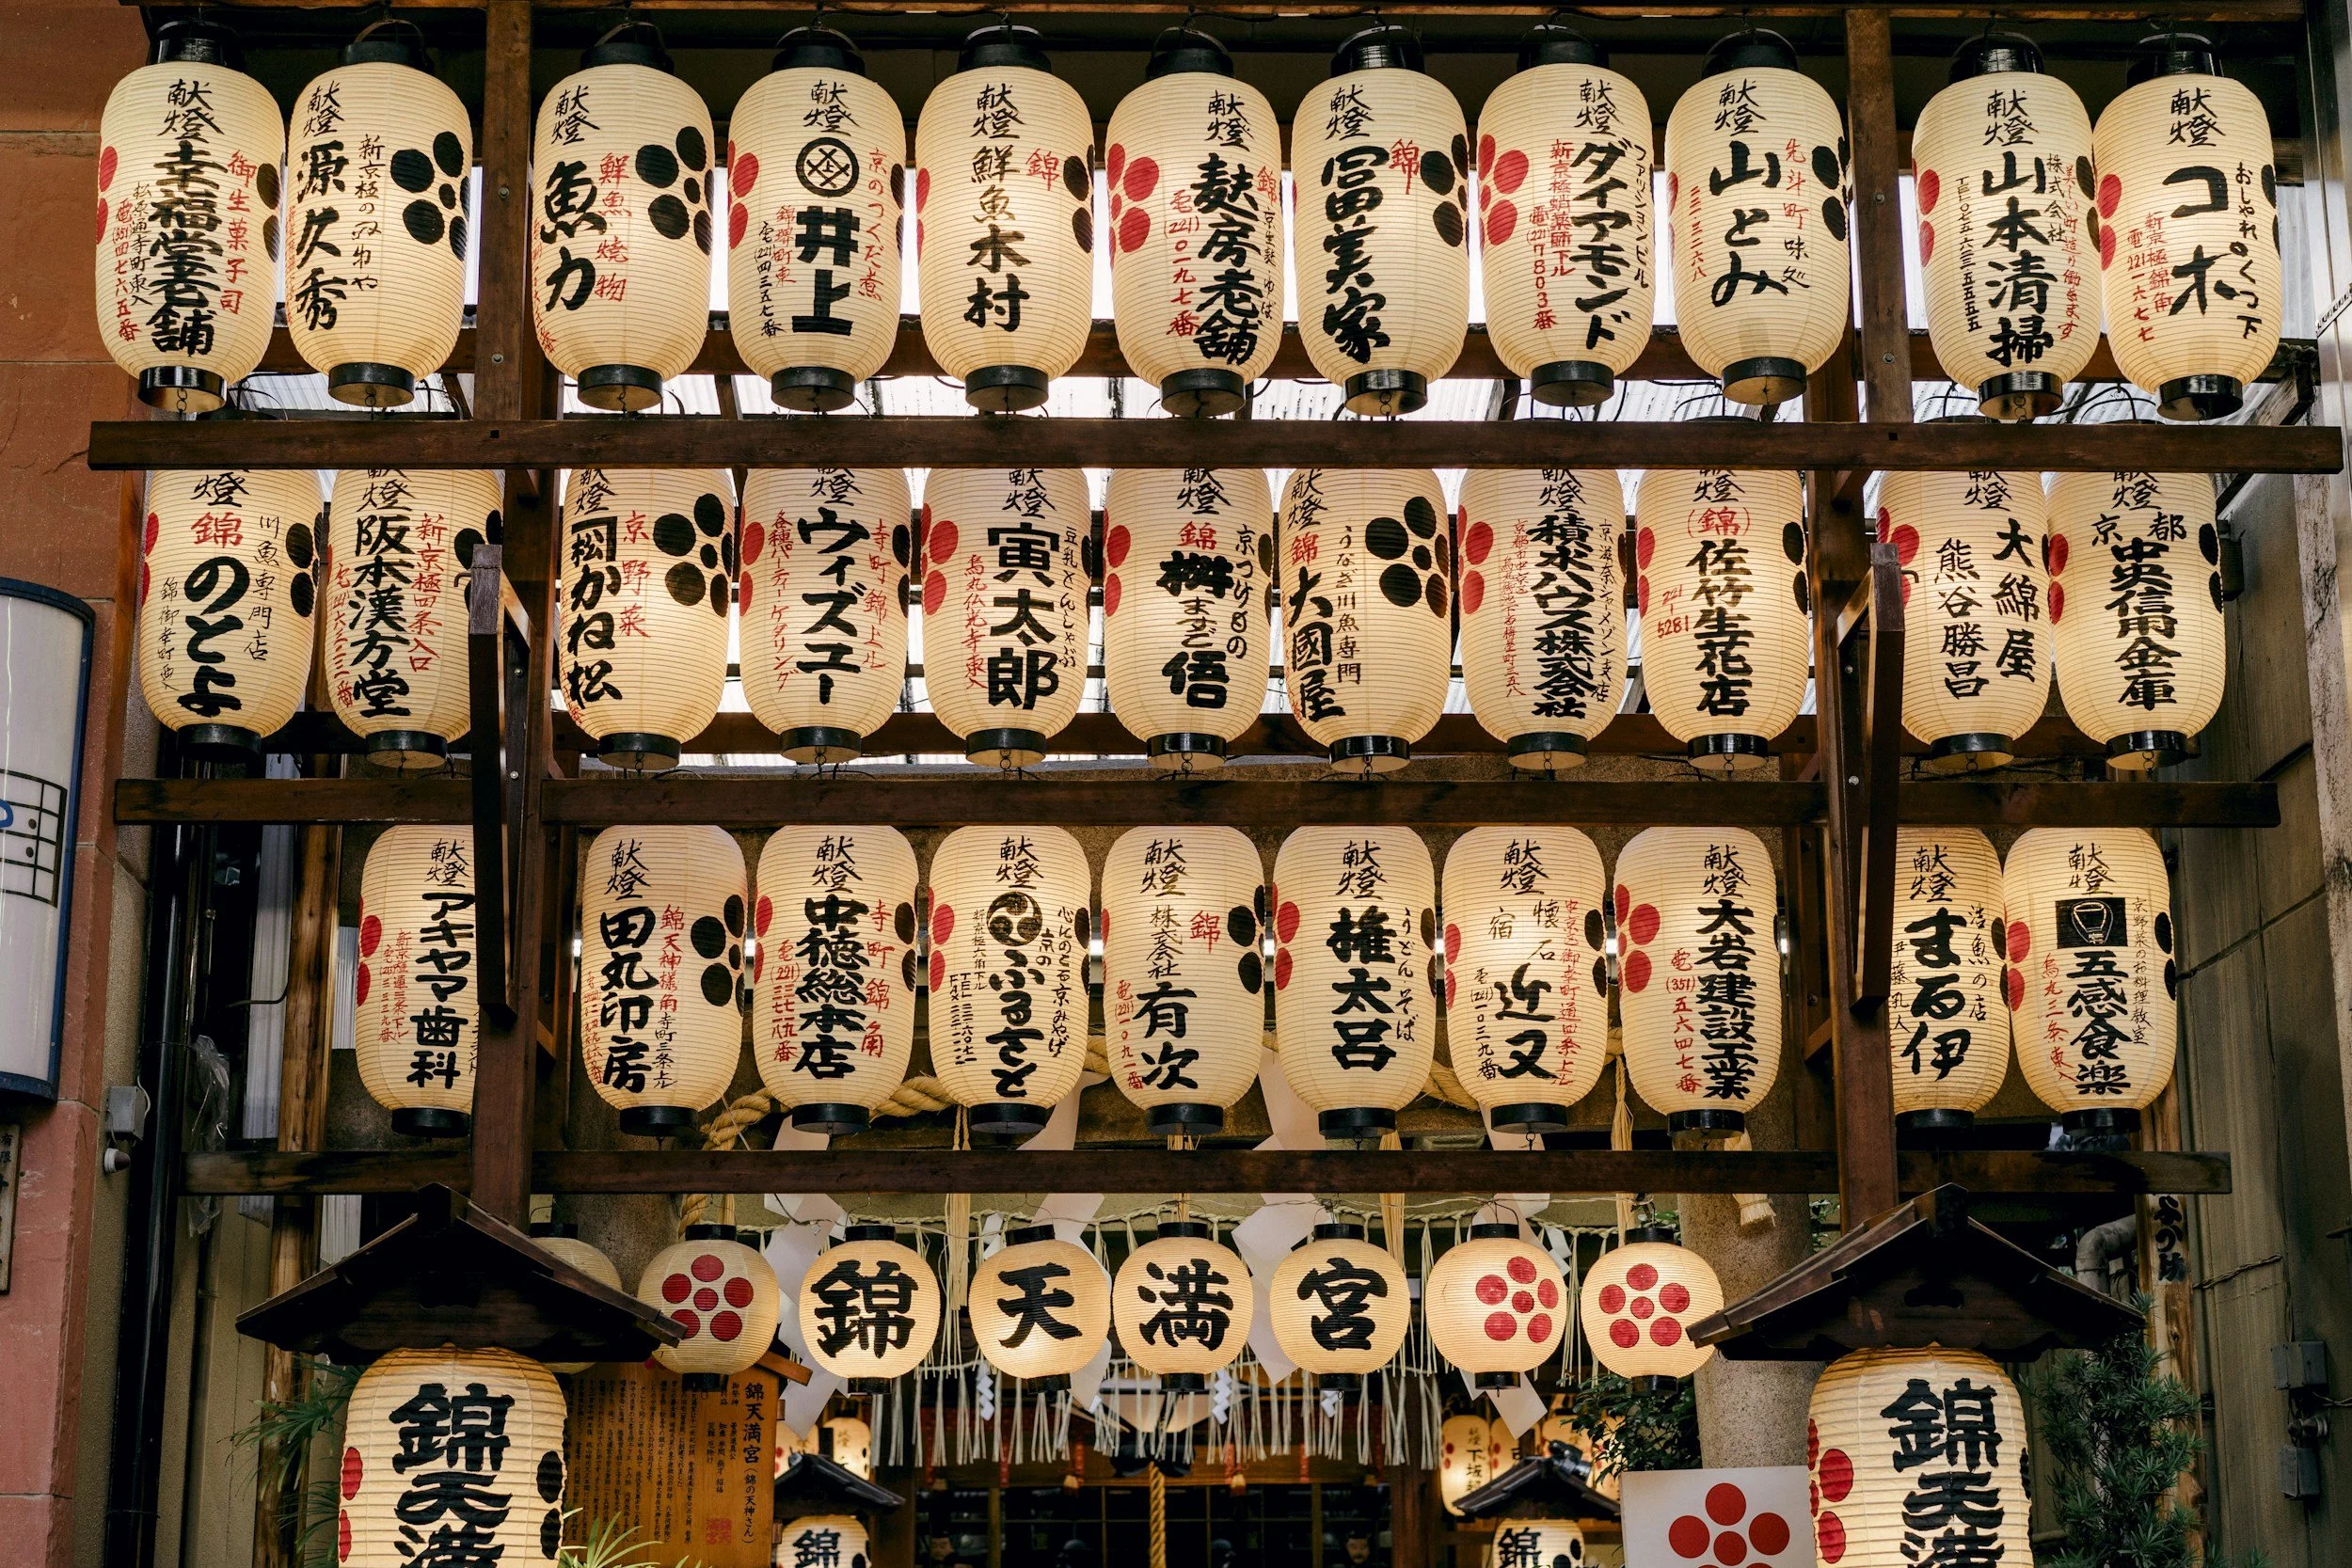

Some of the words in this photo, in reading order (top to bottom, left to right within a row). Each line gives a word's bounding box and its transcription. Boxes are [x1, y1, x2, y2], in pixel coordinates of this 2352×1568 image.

[158, 78, 224, 143] 献燈
[303, 80, 344, 138] 献燈
[551, 85, 600, 146] 献燈
[803, 80, 863, 136] 献燈
[970, 83, 1027, 139] 献燈
[1204, 89, 1255, 152] 献燈
[1325, 84, 1375, 141] 献燈
[1574, 78, 1624, 137] 献燈
[1714, 78, 1768, 136] 献燈
[1983, 87, 2039, 148] 献燈
[2167, 87, 2226, 148] 献燈
[1025, 149, 1062, 192] 錦
[1257, 166, 1279, 206] 錦
[1388, 137, 1421, 195] 錦
[2043, 152, 2069, 244] 株式会社
[219, 150, 258, 315] 御生菓子司
[540, 161, 607, 312] 魚力
[792, 205, 861, 337] 井上
[858, 148, 887, 301] 京のつくだ煮
[1568, 137, 1632, 350] ダイアモンド
[1708, 140, 1789, 308] 山とみ
[1981, 151, 2058, 367] 山本清掃
[190, 470, 250, 508] 燈
[1287, 469, 1327, 531] 献燈
[1692, 469, 1745, 502] 燈
[244, 515, 279, 662] 川魚専門店
[348, 514, 416, 718] 阪本漢方堂
[407, 513, 449, 672] 新京極四条入口
[618, 510, 651, 638] 京野菜
[796, 507, 870, 705] ウィズユー
[987, 521, 1060, 710] 寅太郎
[1528, 515, 1596, 719] 積水ハウス株式会社
[1934, 537, 1990, 700] 熊谷勝昌
[1990, 517, 2041, 683] 大綿屋
[177, 556, 250, 718] のとよ
[1288, 565, 1347, 722] 大國屋
[1686, 538, 1755, 717] 佐竹生花店
[2105, 537, 2182, 711] 中央信用金庫
[425, 838, 470, 888] 献燈
[604, 837, 651, 901] 献燈
[811, 834, 864, 895] 献燈
[994, 834, 1044, 890] 献燈
[1141, 838, 1188, 898] 献燈
[1335, 840, 1389, 901] 献燈
[1500, 838, 1549, 895] 献燈
[1702, 844, 1751, 898] 献燈
[1910, 844, 1958, 903] 献燈
[2068, 843, 2115, 895] 献燈
[861, 898, 896, 1059] 寺町錦角
[1189, 910, 1221, 955] 錦
[406, 892, 475, 1089] アキヤマ歯科
[599, 906, 660, 1094] 田丸印房
[985, 949, 1045, 1099] ふるさと
[1325, 905, 1397, 1072] 権太呂
[1492, 963, 1559, 1080] 近又
[1693, 898, 1759, 1101] 大岩建設工業
[2066, 949, 2134, 1096] 五感食楽
[810, 1259, 919, 1358] 錦
[997, 1261, 1083, 1349] 天
[1136, 1258, 1234, 1352] 満
[1296, 1257, 1389, 1351] 宮
